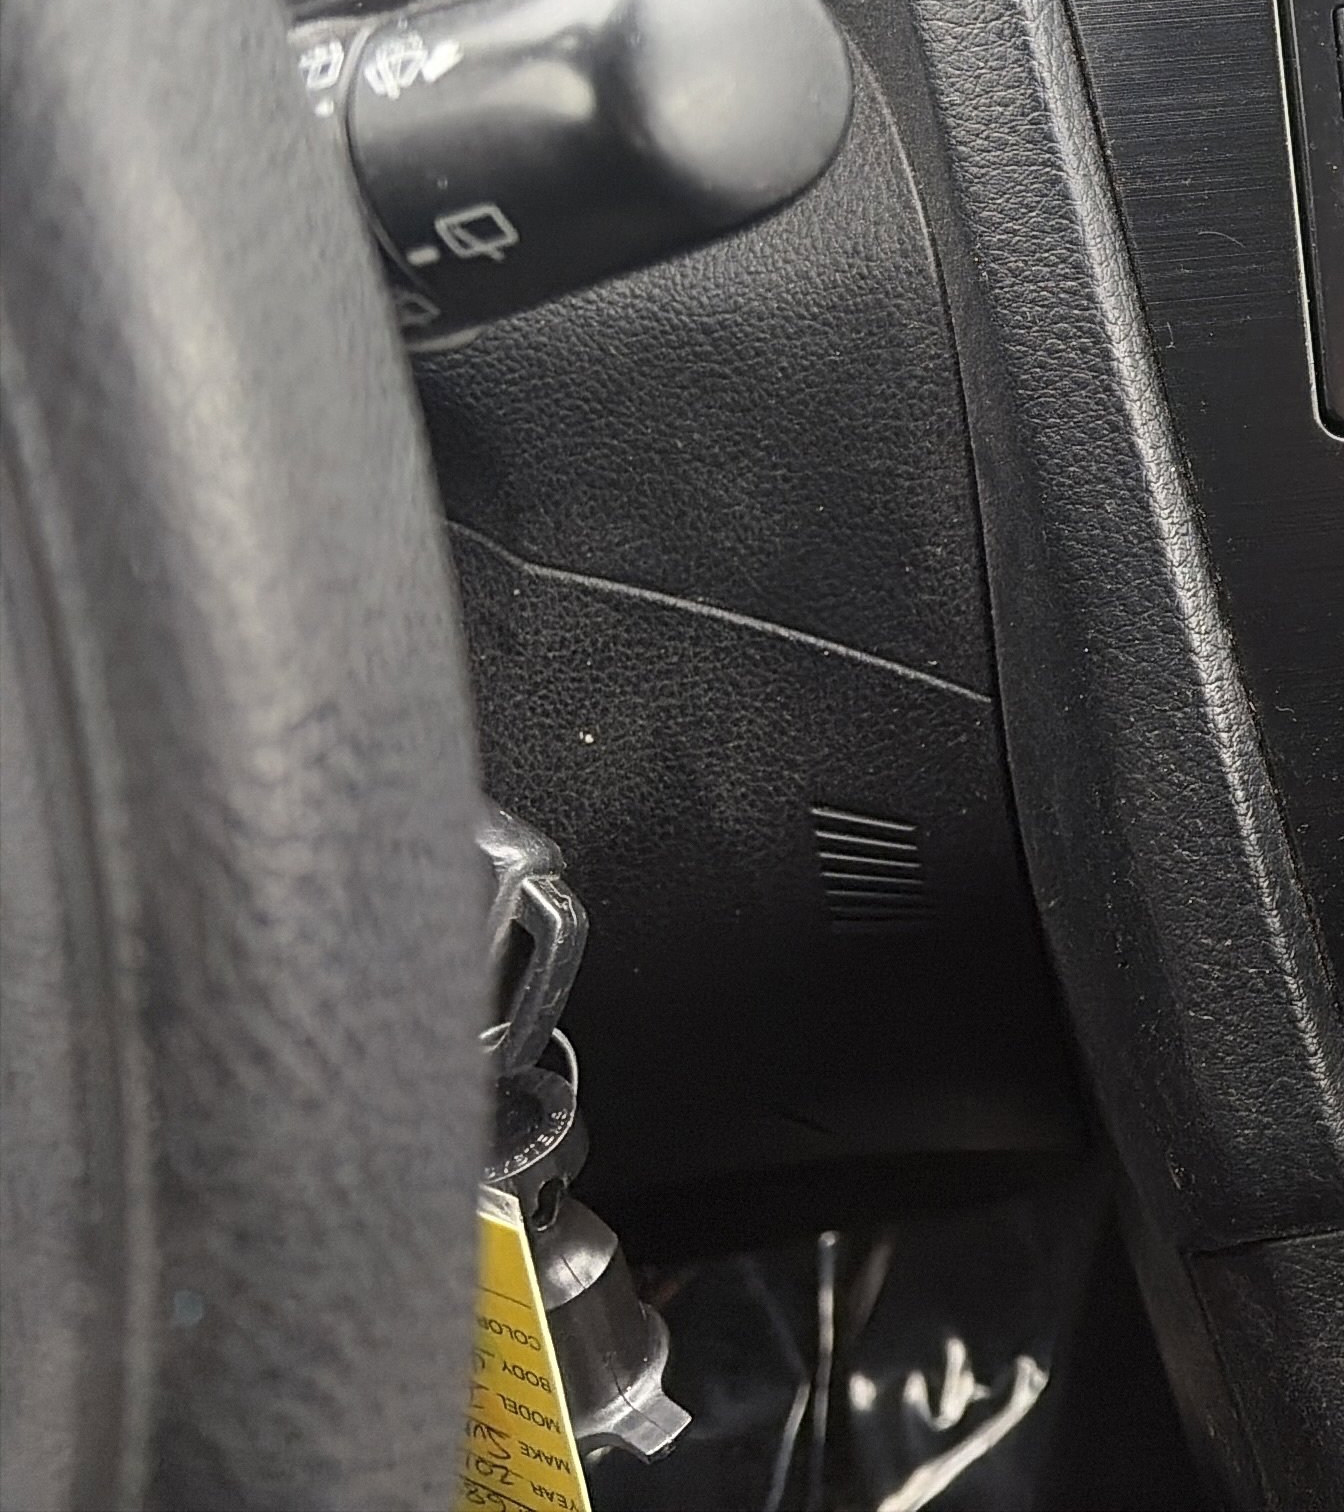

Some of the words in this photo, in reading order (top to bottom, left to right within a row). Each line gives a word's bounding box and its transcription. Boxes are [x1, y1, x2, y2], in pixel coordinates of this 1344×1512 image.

[502, 1360, 552, 1393] BODY
[497, 1393, 561, 1434] MODEL
[518, 1441, 571, 1475] MAKE
[529, 1480, 581, 1512] YEAR
